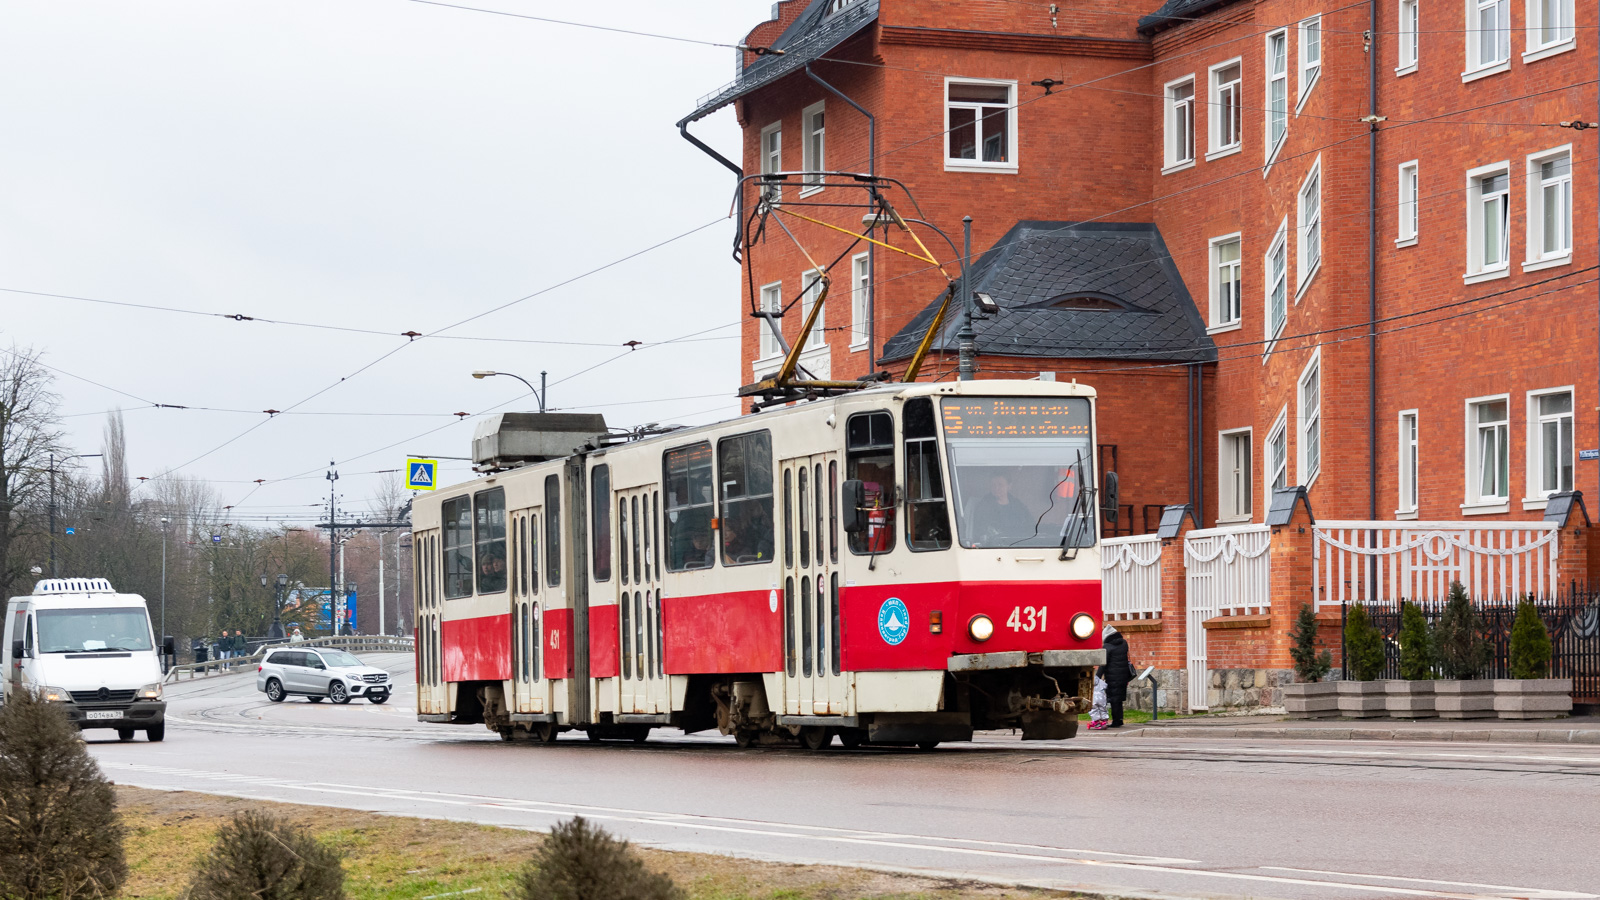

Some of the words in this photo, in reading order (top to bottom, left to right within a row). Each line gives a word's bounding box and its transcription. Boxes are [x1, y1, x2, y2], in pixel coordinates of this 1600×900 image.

[943, 405, 963, 434] 5
[1006, 605, 1047, 632] 431
[550, 629, 560, 650] 431
